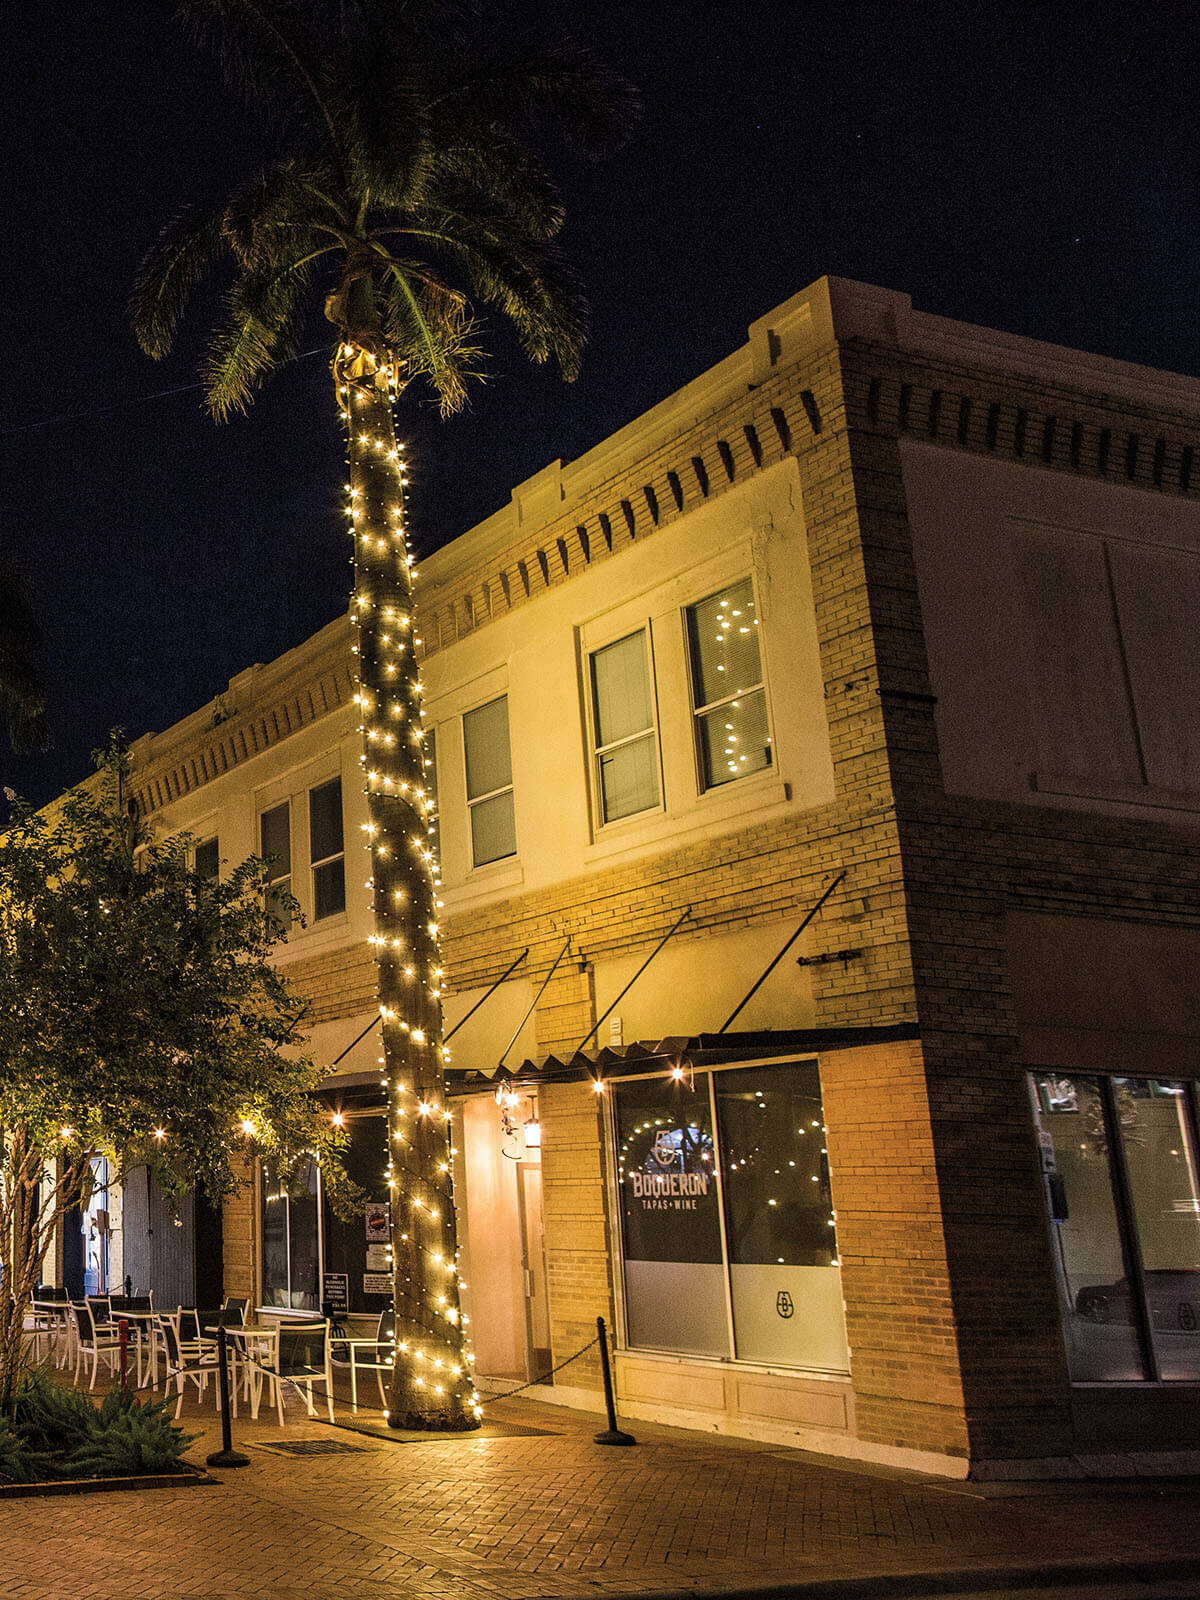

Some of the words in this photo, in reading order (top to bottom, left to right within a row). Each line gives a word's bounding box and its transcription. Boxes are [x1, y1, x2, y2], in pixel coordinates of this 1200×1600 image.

[633, 1172, 708, 1198] BOQUERON
[642, 1200, 669, 1210] TAPAS
[674, 1200, 697, 1210] WINE
